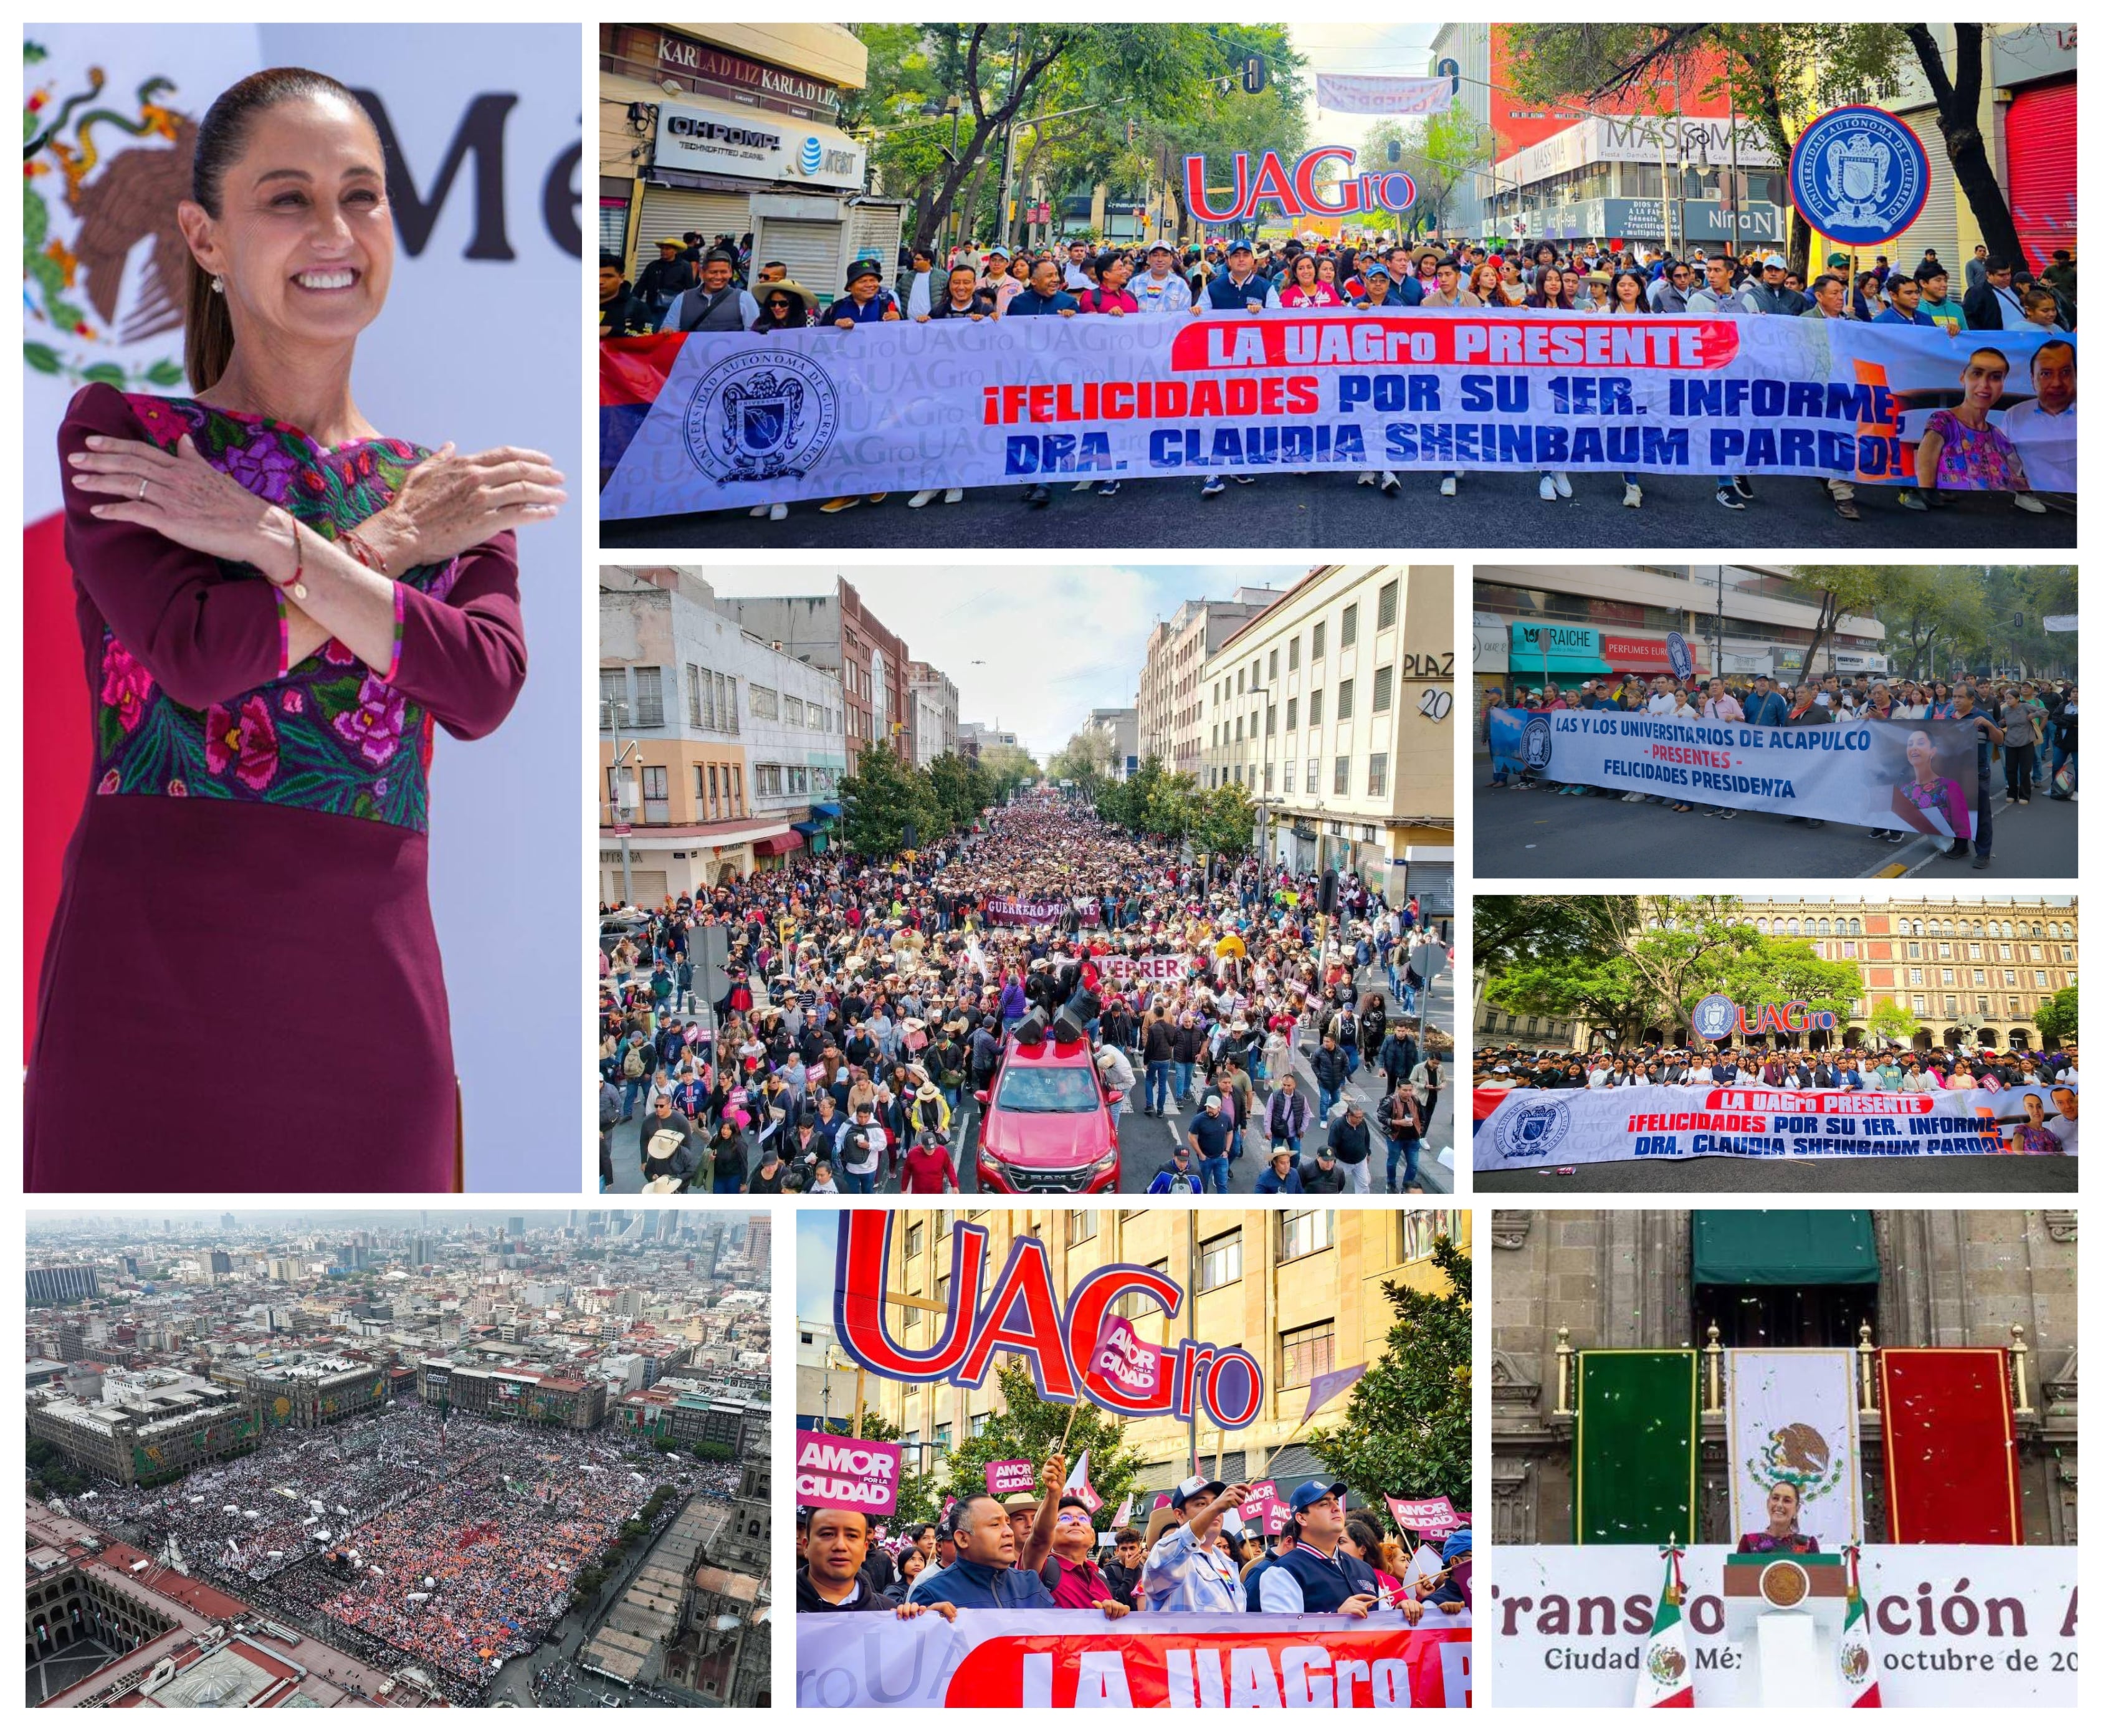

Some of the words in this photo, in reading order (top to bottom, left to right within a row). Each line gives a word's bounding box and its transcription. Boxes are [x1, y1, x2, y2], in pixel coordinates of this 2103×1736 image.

[761, 69, 805, 99] KARLA
[1606, 119, 1762, 150] MASSIMA
[1829, 118, 1892, 139] AUTÓNOMA
[1894, 140, 1907, 155] DE
[1183, 145, 1417, 225] UAGro
[1804, 133, 1826, 210] UNIVERSIDAD
[1889, 158, 1914, 216] GUERRERO
[1208, 328, 1267, 368] LA
[1284, 324, 1436, 366] UAGro
[1455, 325, 1704, 365] PRESENTE
[722, 353, 805, 376] AUTÓNOMA
[809, 371, 823, 388] DE
[984, 375, 1319, 426] ¡FELICIDADES
[1339, 374, 1440, 413] POR
[1461, 374, 1528, 413] SU
[1553, 376, 1647, 416] 1ER.
[1670, 378, 1905, 433] INFORME,
[690, 376, 718, 469] UNIVERSIDAD
[802, 392, 833, 463] GUERRERO
[827, 435, 915, 467] AGro
[1004, 431, 1128, 476] DRA.
[1149, 423, 1367, 469] CLAUDIA
[1385, 422, 1689, 466] SHEINBAUM
[1710, 427, 1904, 477] PARDO!
[1609, 644, 1649, 655] PERFUMES
[1419, 689, 1453, 719] 20
[1556, 717, 1578, 733] LAS
[1581, 718, 1590, 734] Y
[1593, 719, 1617, 735] LOS
[1621, 720, 1733, 746] UNIVERSITARIOS
[1739, 728, 1766, 748] DE
[1769, 729, 1871, 751] ACAPULCO
[1652, 743, 1732, 770] PRESENTES
[1604, 758, 1688, 786] FELICIDADES
[1691, 770, 1796, 799] PRESIDENTA
[988, 900, 1044, 917] GUERRERO
[1737, 1000, 1836, 1036] UAGro
[1720, 1092, 1746, 1110] LA
[1752, 1094, 1816, 1112] UAGro
[1824, 1095, 1921, 1114] PRESENTE
[1628, 1112, 1766, 1133] ¡FELICIDADES
[1774, 1116, 1818, 1133] POR
[1826, 1117, 1856, 1135] SU
[1862, 1118, 1900, 1136] 1ER.
[1909, 1117, 2003, 1136] INFORME,
[1634, 1136, 1682, 1155] DRA.
[1692, 1134, 1786, 1155] CLAUDIA
[1793, 1137, 1920, 1157] SHEINBAUM
[1927, 1137, 2005, 1155] PARDO!
[834, 1209, 1264, 1430] UAGro
[1107, 1327, 1155, 1370] AMOR
[1100, 1351, 1155, 1388] CIUDAD
[798, 1443, 895, 1478] AMOR
[996, 1464, 1032, 1477] AMOR
[796, 1474, 890, 1505] CIUDAD
[996, 1477, 1034, 1489] CIUDAD
[1244, 1485, 1274, 1504] AMOR
[1271, 1505, 1292, 1520] AMO
[1398, 1502, 1449, 1515] AMOR
[1401, 1515, 1453, 1527] CIUDAD
[1545, 1646, 1640, 1670] Ciudad
[1883, 1648, 1995, 1671] octubre
[2005, 1648, 2039, 1671] de
[1166, 1646, 1411, 1708] UAGro
